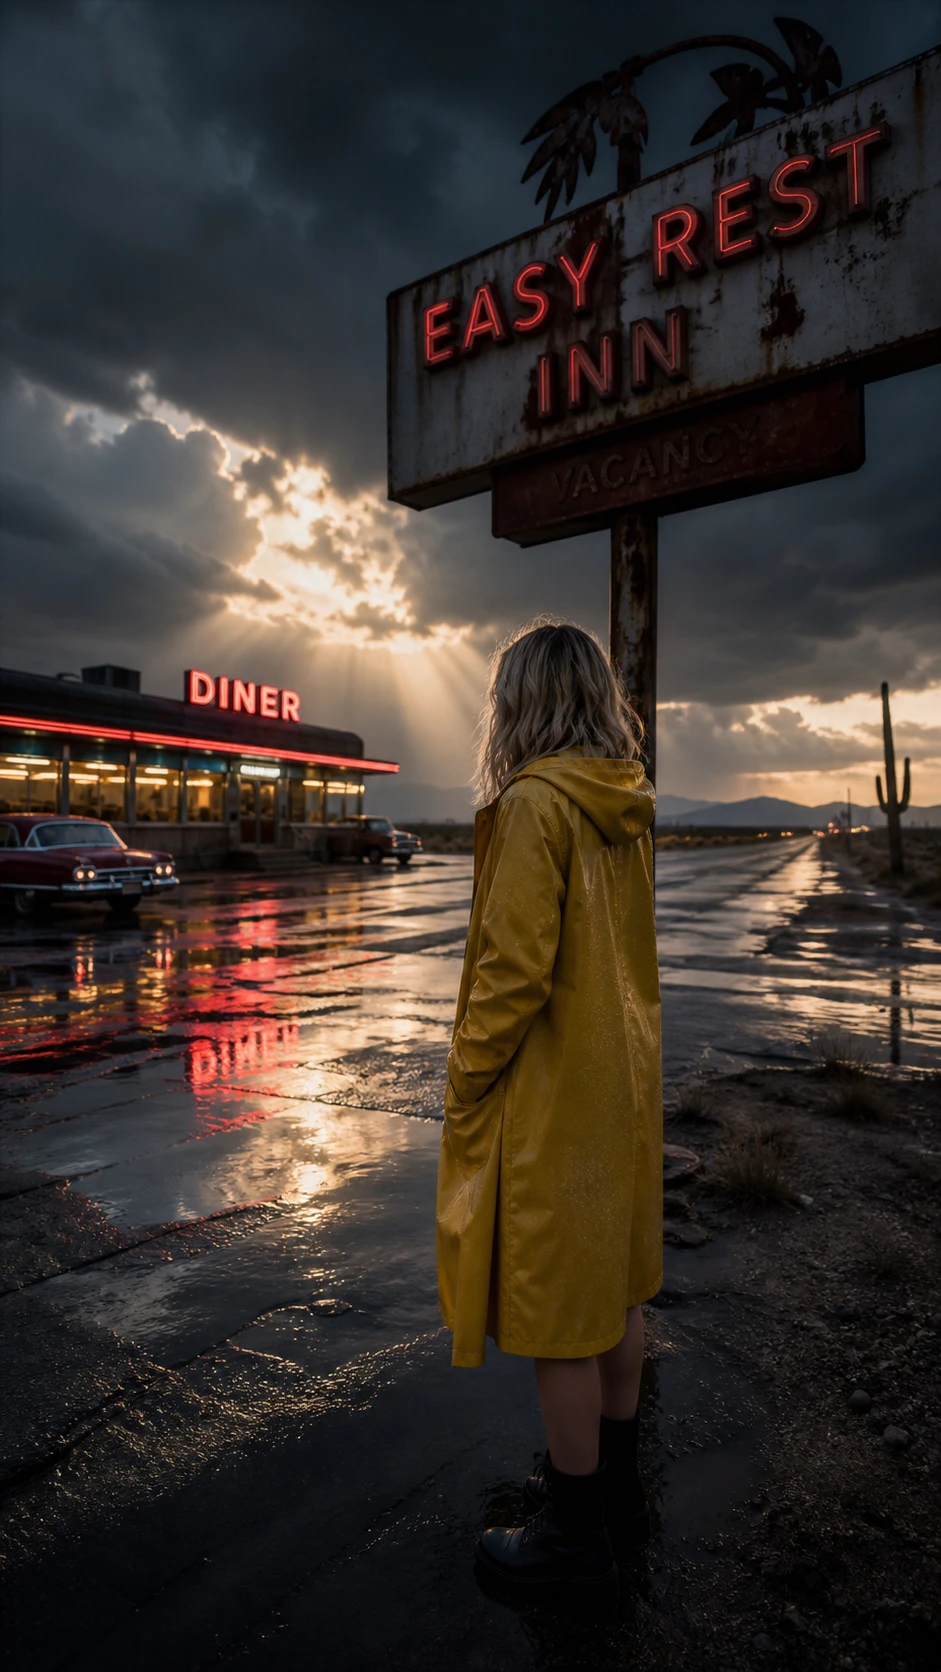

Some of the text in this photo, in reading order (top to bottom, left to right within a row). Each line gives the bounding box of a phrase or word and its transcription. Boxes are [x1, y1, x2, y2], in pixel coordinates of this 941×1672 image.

[423, 121, 891, 372] EASY REST
[536, 305, 688, 422] INN
[551, 416, 759, 503] VACANCY
[187, 669, 301, 723] DINER
